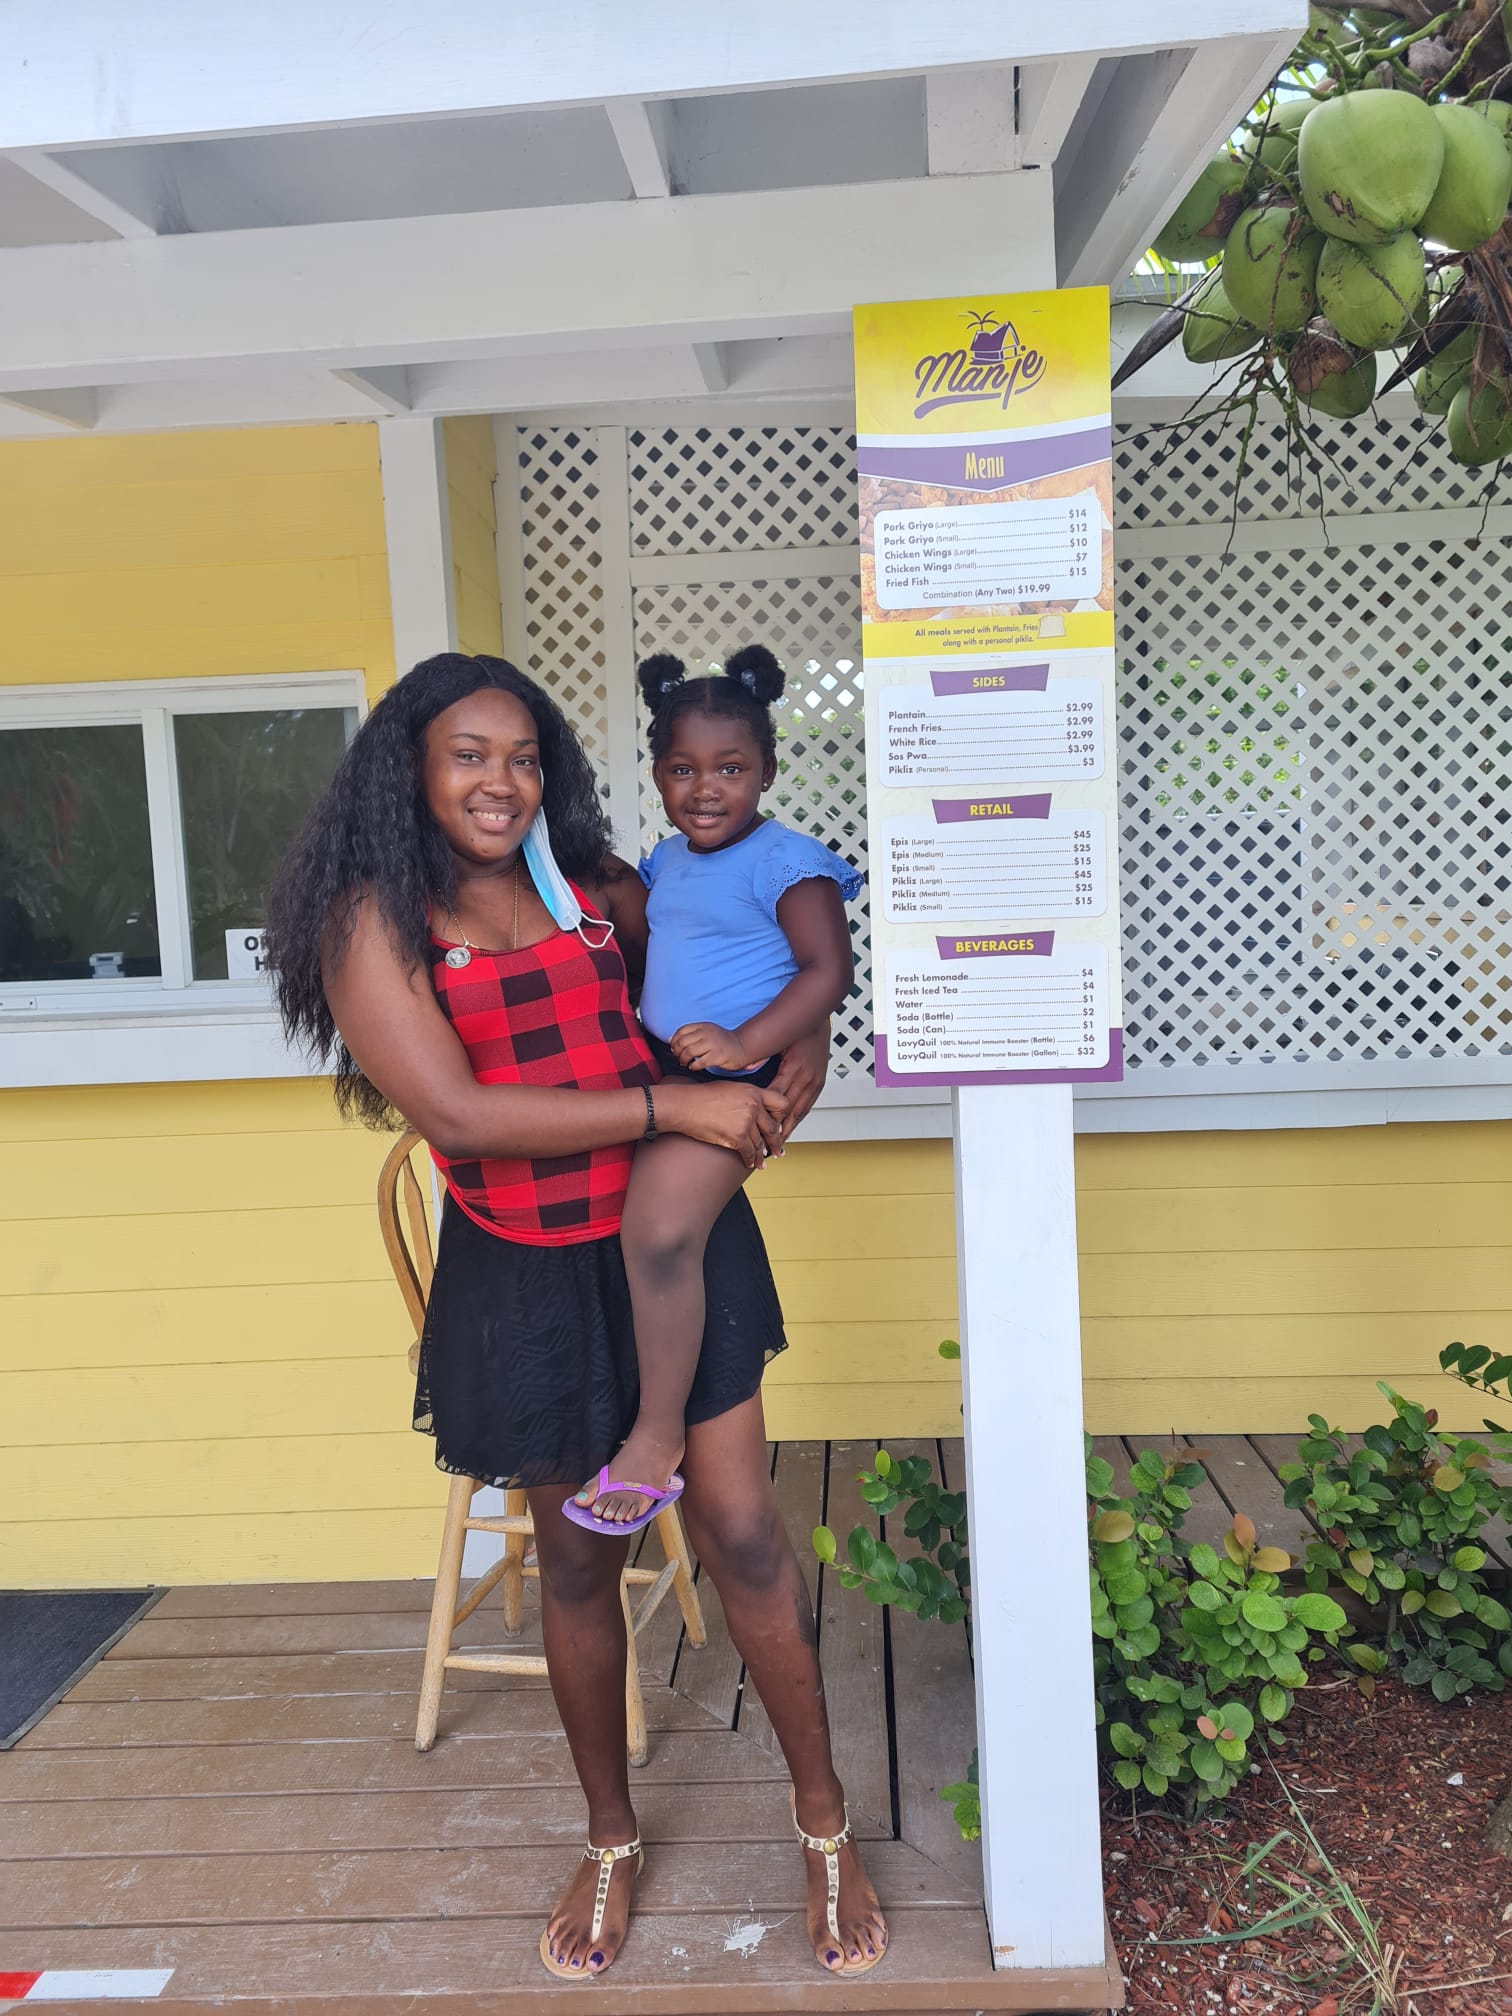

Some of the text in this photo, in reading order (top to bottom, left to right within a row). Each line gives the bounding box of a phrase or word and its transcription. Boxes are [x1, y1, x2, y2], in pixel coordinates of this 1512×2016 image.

[914, 344, 1046, 411] Manje
[964, 451, 1005, 480] Menu
[883, 508, 1087, 532] Pork Griyo (Large) $14
[884, 523, 1088, 546] Pork Griyo (Small) $12
[884, 538, 1088, 560] Chicken Wings (Large) $10
[885, 552, 1088, 574] Chicken Wings (Small) $7
[886, 567, 1087, 588] Fried Fish $15
[923, 584, 1051, 600] Combination (Any Two) $19.99
[915, 628, 926, 636] All
[928, 627, 951, 636] meals
[953, 626, 975, 635] served
[977, 625, 991, 633] with
[993, 624, 1021, 633] Plantain,
[943, 639, 961, 648] along
[963, 637, 977, 646] with
[985, 635, 1014, 647] personal
[972, 676, 1006, 688] SIDES
[888, 702, 1093, 720] Plantain $2.99
[888, 716, 1094, 734] French Fries $2.99
[889, 730, 1093, 747] White Rice $2.99
[888, 743, 1095, 761] Sos Pwa $3.99
[888, 757, 1095, 774] Pikliz (Personal) $3
[969, 803, 1014, 816] RETAIL
[891, 830, 1092, 848] Epis (Large) $45
[891, 843, 1091, 861] Epis (Medium) $25
[891, 857, 1092, 874] Epis (Small) $15
[892, 870, 1092, 886] Pikliz (Large) $45
[891, 883, 1093, 899] Pikliz (Medium) $25
[893, 897, 1093, 912] Pikliz (Small) $15
[955, 938, 1035, 953] BEVERAGES
[895, 968, 1094, 983] Fresh Lemonade $4
[895, 981, 1095, 996] Fresh Iced Tea $4
[895, 994, 1094, 1009] Water $1
[896, 1007, 1095, 1023] Soda (Bottle) $2
[897, 1021, 1094, 1036] Soda (Can) $1
[897, 1038, 937, 1049] LovyQuil
[1031, 1036, 1056, 1045] (Bottle)
[1083, 1033, 1095, 1043] $6
[897, 1051, 937, 1062] LovyQuil
[1031, 1049, 1059, 1058] (Gallon)
[1077, 1047, 1095, 1056] $32
